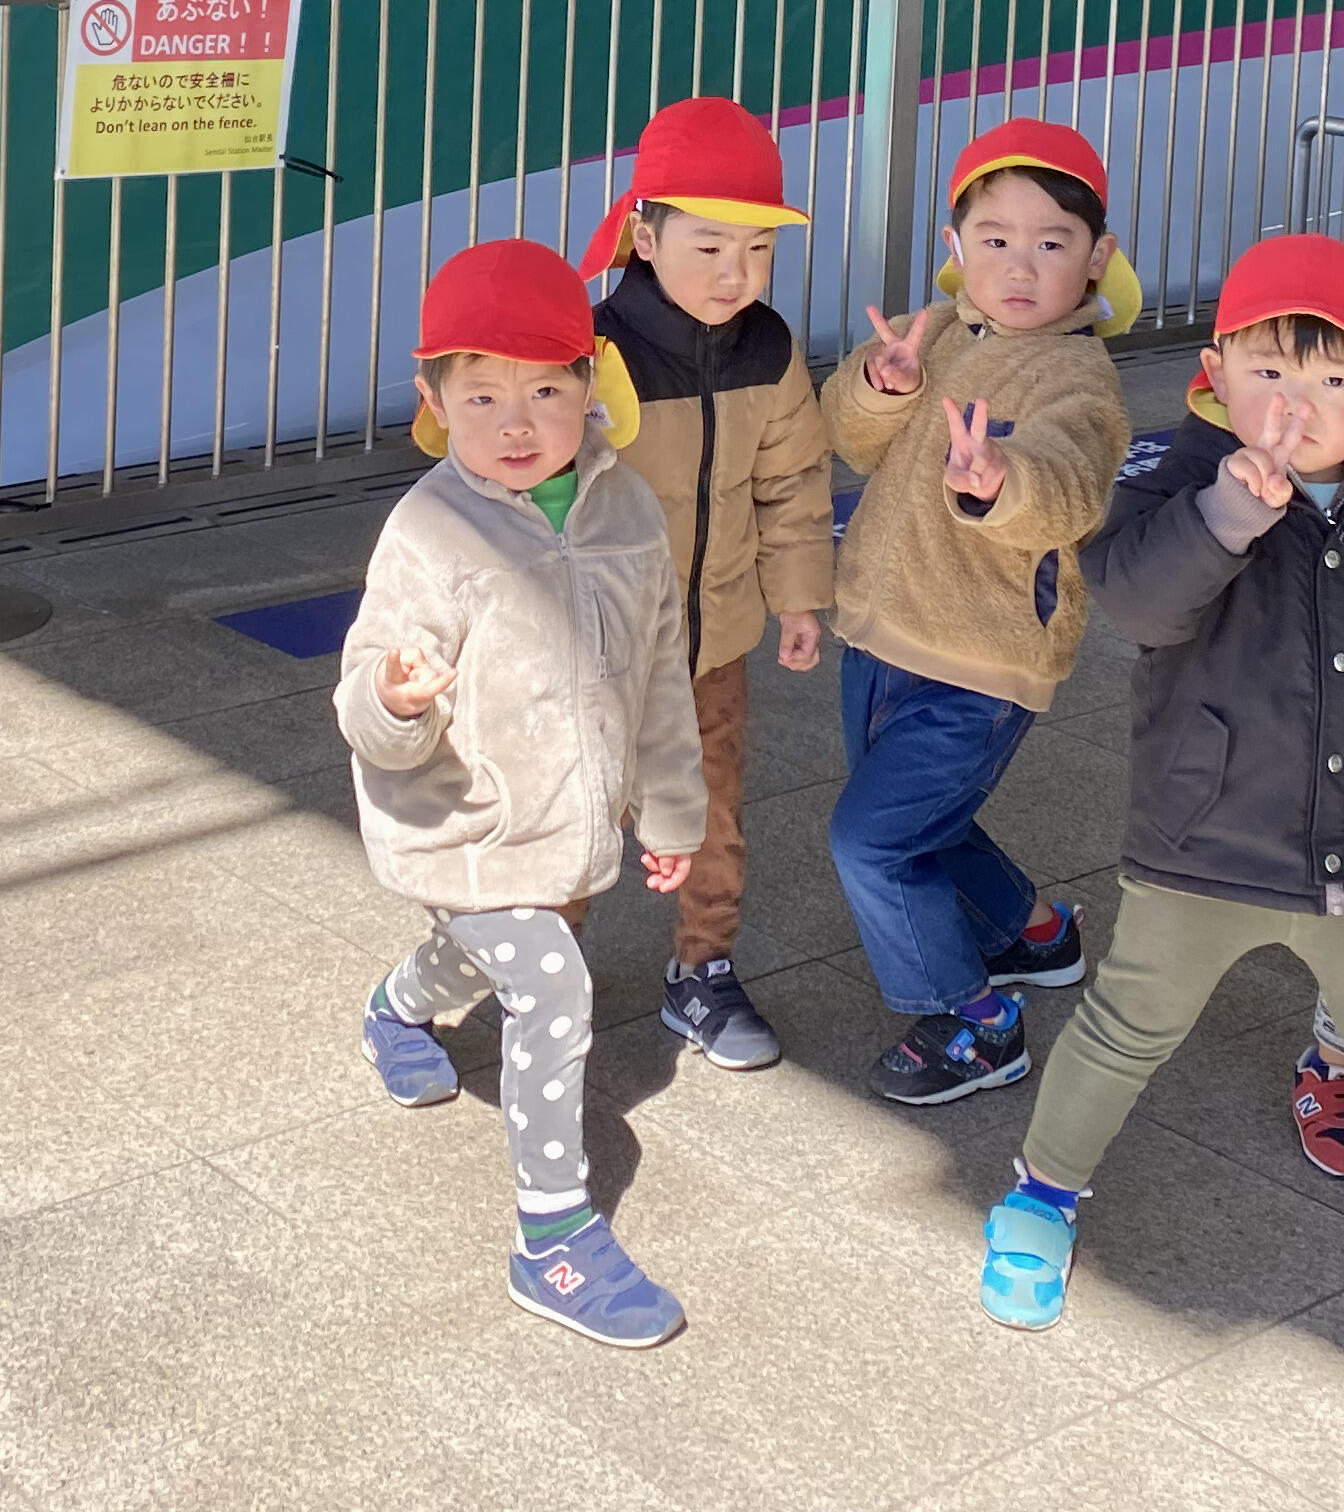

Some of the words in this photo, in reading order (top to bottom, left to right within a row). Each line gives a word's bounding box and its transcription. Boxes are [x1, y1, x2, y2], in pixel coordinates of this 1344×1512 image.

[111, 72, 250, 91] 危ないので安全柵に
[138, 119, 167, 133] lean
[171, 120, 189, 131] on
[193, 116, 215, 131] the
[218, 115, 258, 129] fence.
[1295, 1092, 1323, 1120] N
[544, 1261, 586, 1296] N
